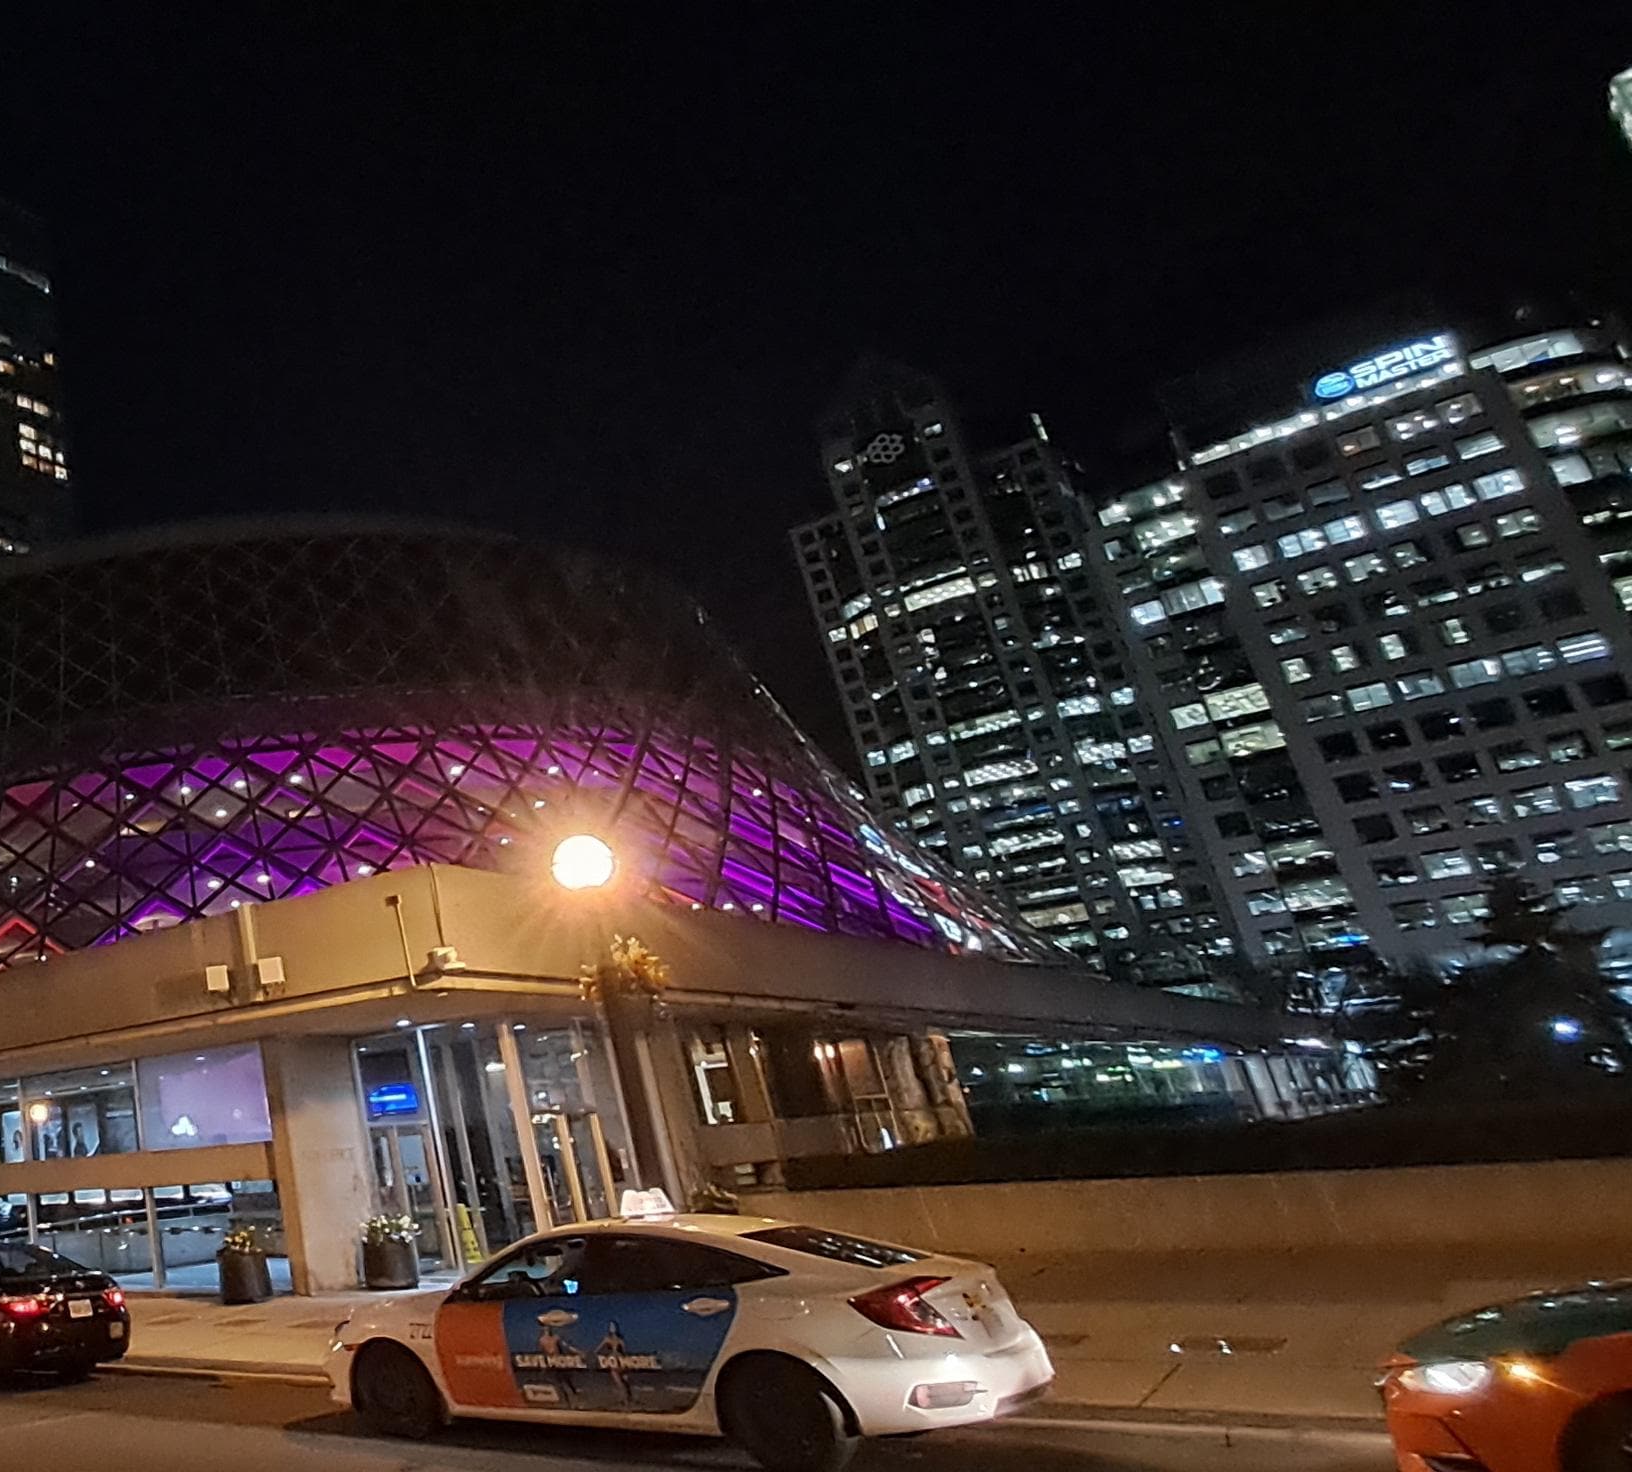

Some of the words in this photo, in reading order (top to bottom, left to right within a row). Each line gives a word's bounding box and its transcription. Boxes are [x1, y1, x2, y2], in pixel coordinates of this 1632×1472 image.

[1349, 334, 1450, 375] SPIN
[1353, 347, 1454, 388] MASTER
[514, 1353, 548, 1369] SAVE
[597, 1354, 618, 1369] DO
